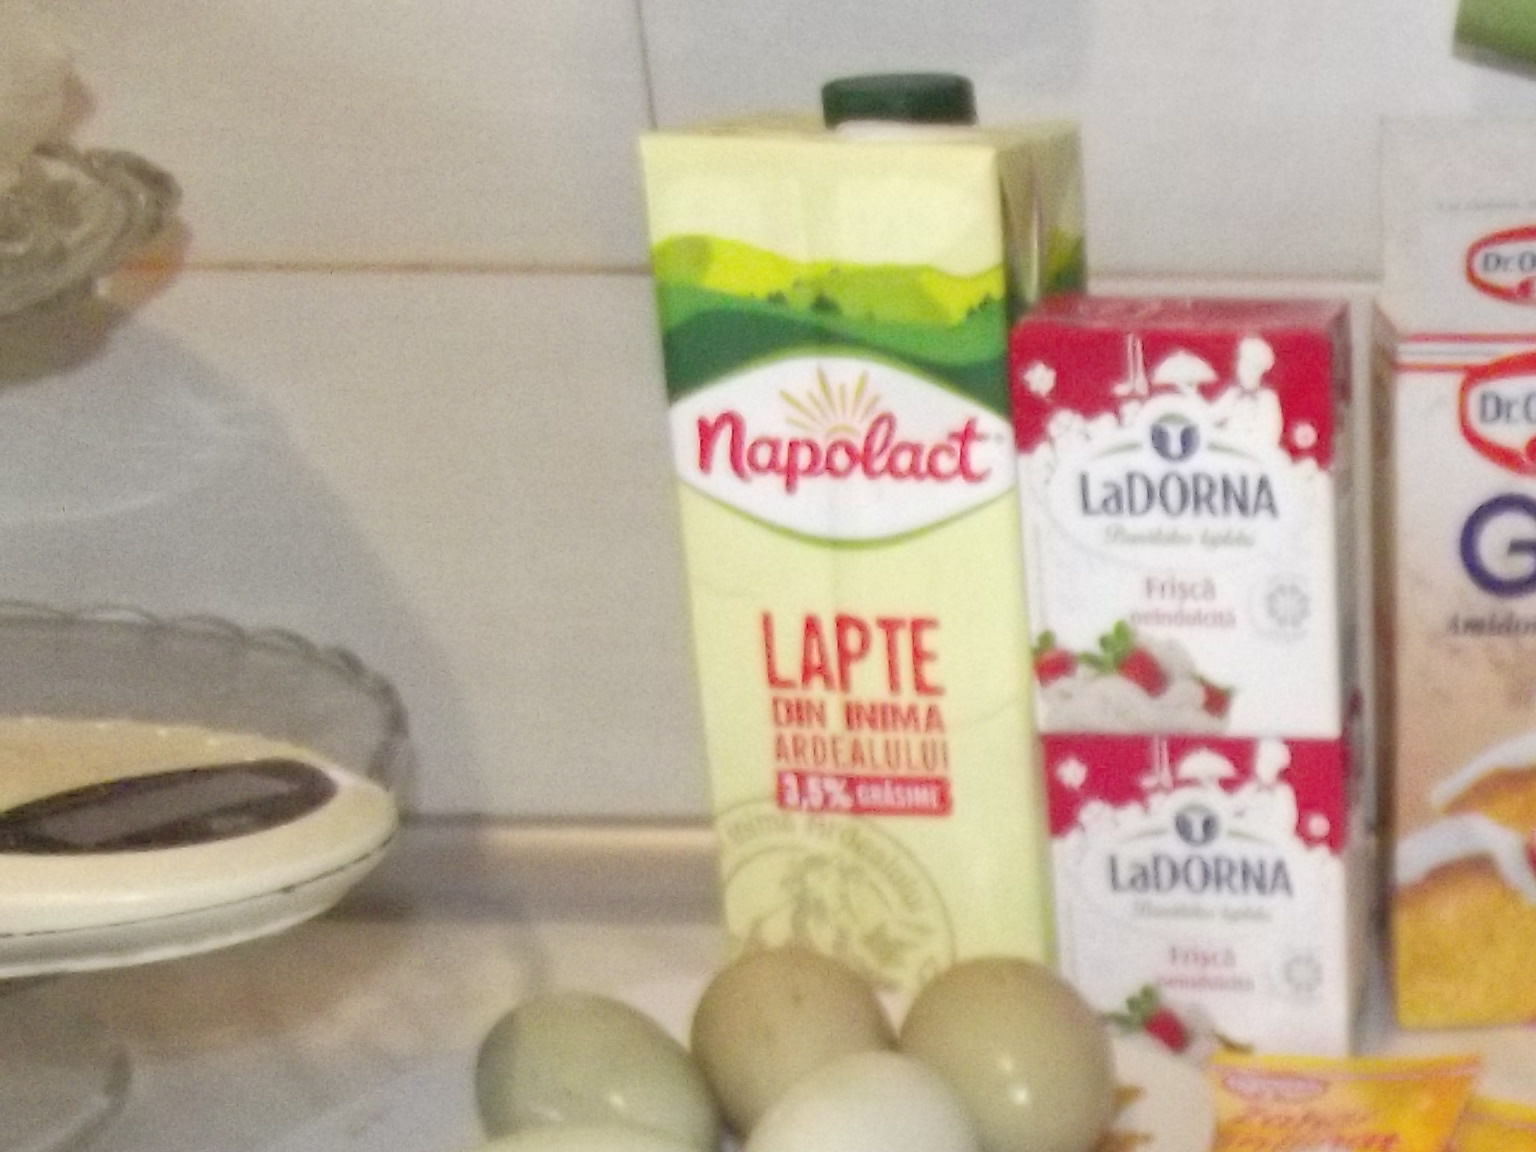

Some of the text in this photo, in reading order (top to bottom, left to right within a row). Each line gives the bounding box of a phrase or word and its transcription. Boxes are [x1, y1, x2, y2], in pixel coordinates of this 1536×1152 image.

[696, 410, 993, 495] Napolact
[1080, 471, 1279, 519] LaDORNA
[762, 612, 945, 696] LAPTE
[845, 702, 945, 733] INIMA
[776, 734, 949, 770] ARDEALULUI
[1109, 855, 1294, 898] LaDORNA
